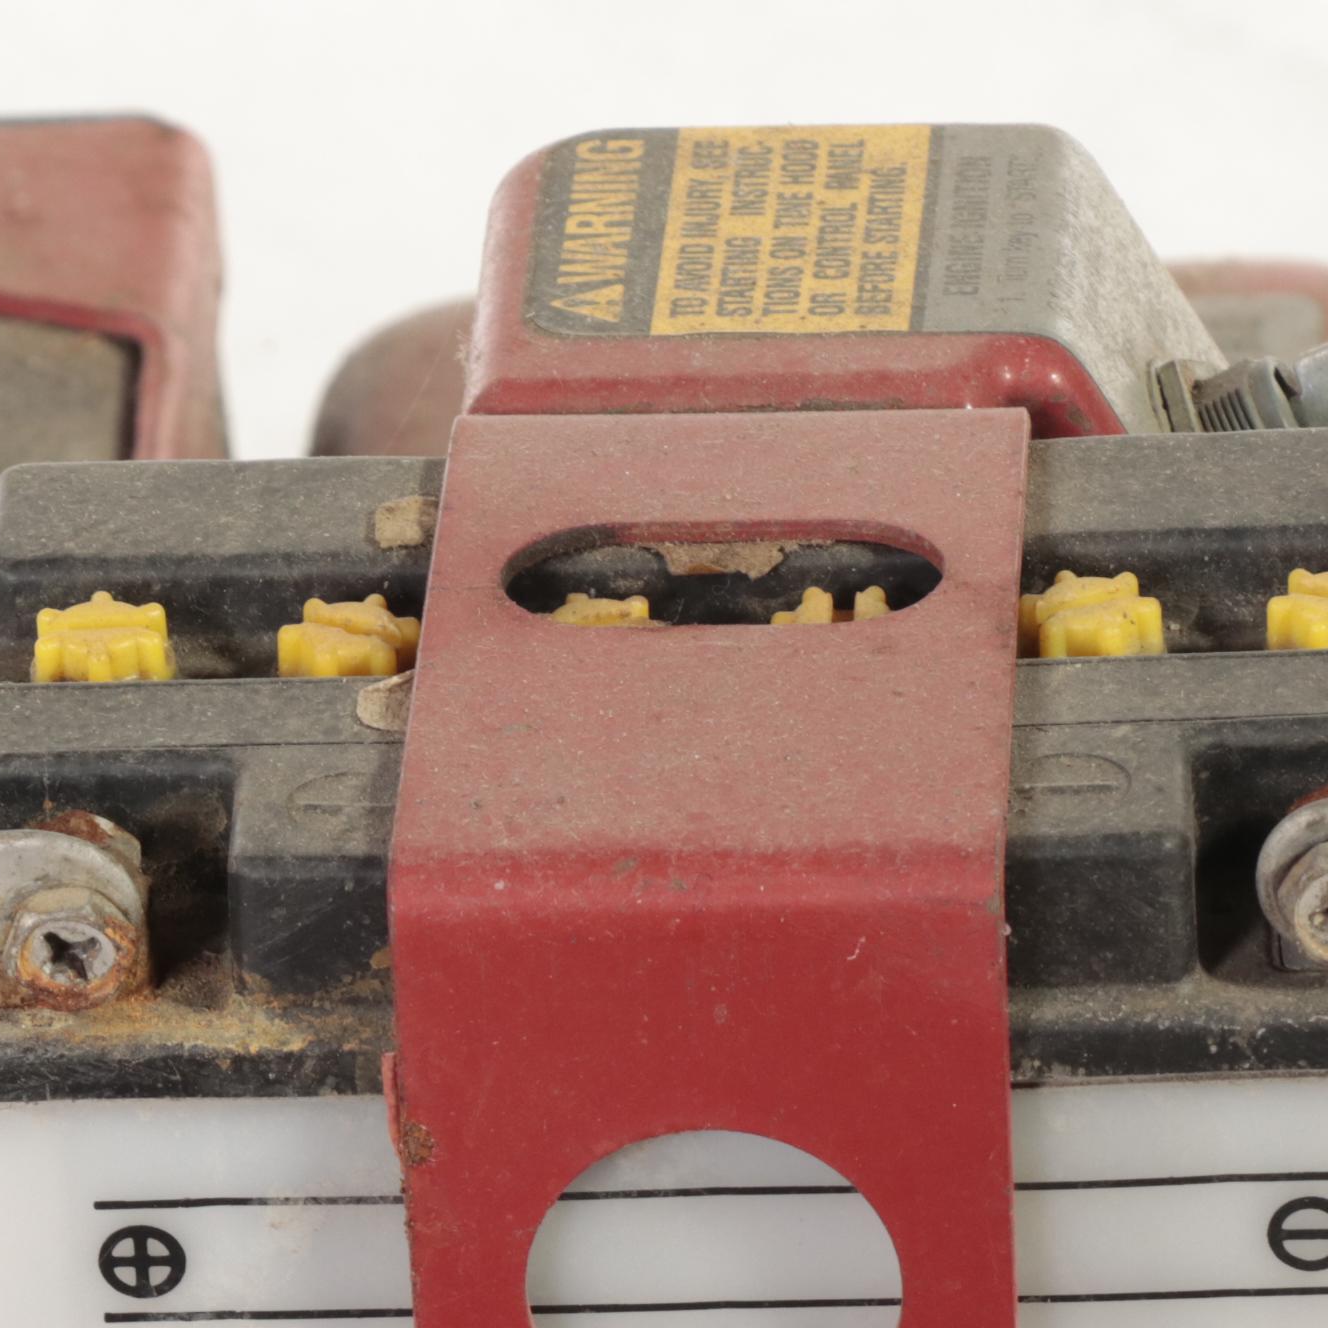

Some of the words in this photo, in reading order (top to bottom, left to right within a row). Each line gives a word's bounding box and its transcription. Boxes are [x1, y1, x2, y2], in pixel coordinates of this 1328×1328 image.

[692, 139, 730, 170] SEE
[732, 139, 774, 217] INSTRUC-
[780, 139, 820, 185] HOOD
[826, 139, 866, 190] PANEL
[557, 139, 646, 285] WARNING
[685, 175, 729, 238] INJURY,
[774, 192, 815, 229] TINE
[865, 162, 908, 245] STARTING.
[950, 156, 992, 229] IGNITION
[675, 245, 716, 293] AVOID
[769, 236, 809, 261] ON
[814, 202, 858, 281] CONTROL
[942, 232, 985, 297] ENGINE
[720, 236, 762, 318] STARTING
[762, 266, 804, 317] TIONS
[808, 293, 847, 318] OR
[856, 251, 900, 316] BEFORE
[670, 296, 709, 318] TO
